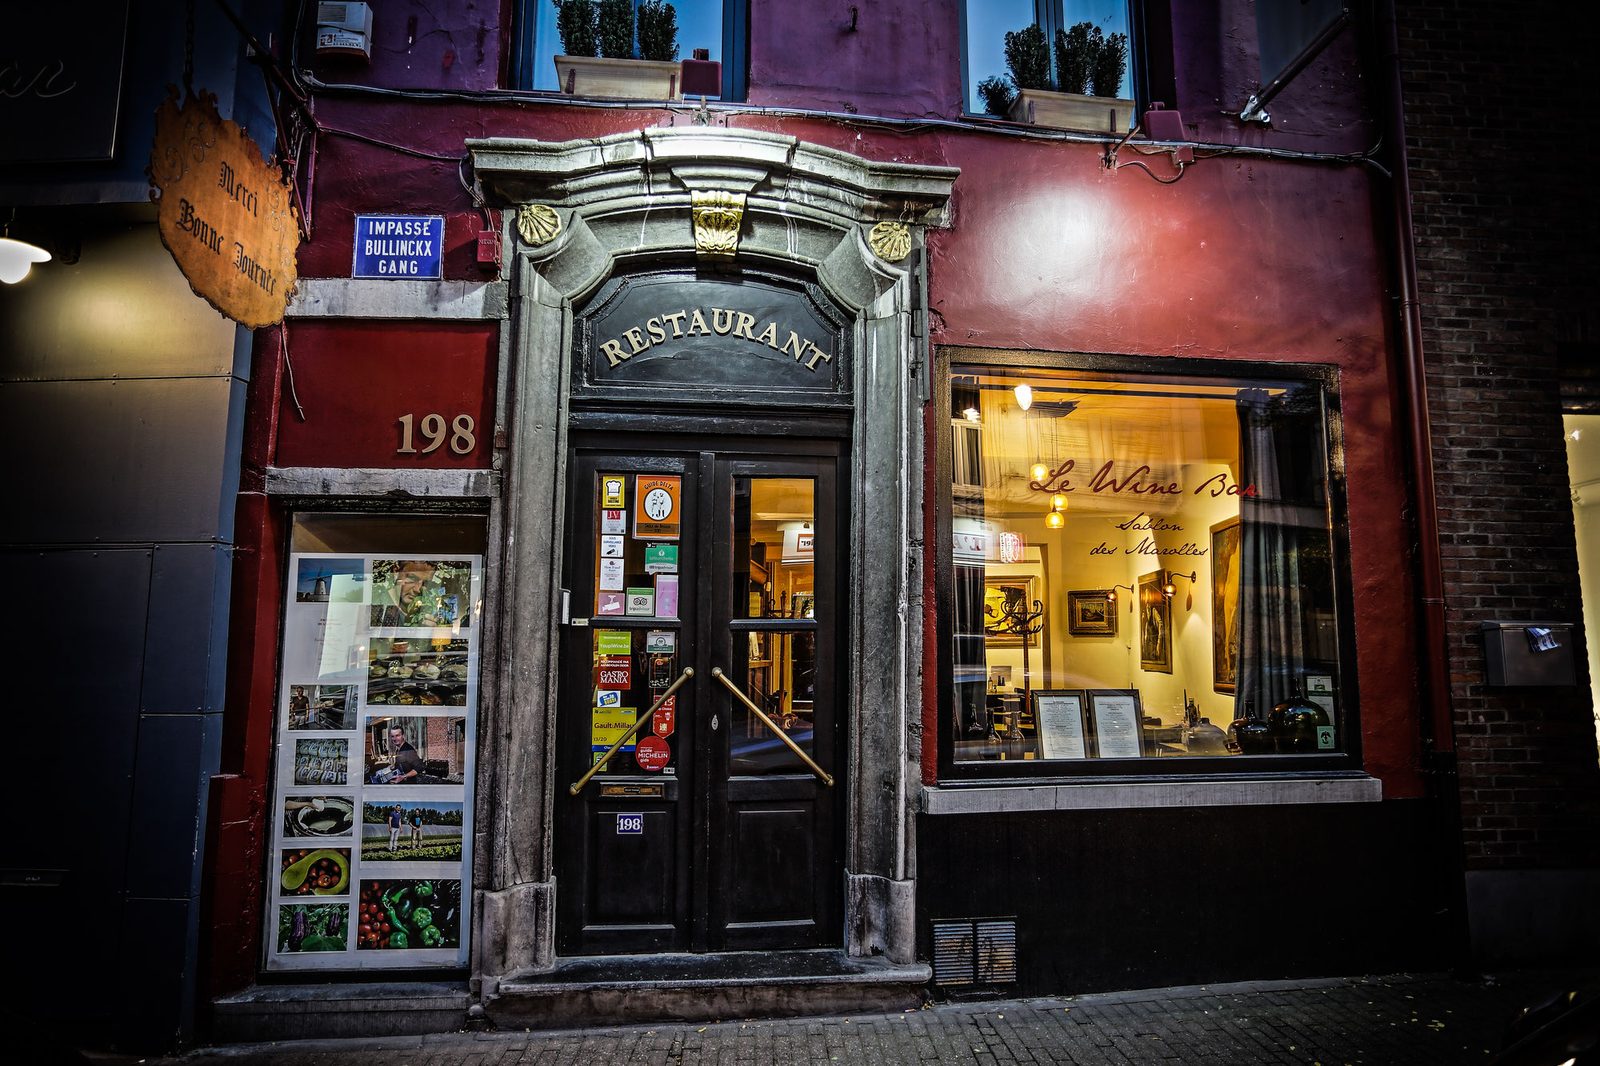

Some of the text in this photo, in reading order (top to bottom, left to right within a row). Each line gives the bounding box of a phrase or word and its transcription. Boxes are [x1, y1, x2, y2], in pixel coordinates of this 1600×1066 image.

[217, 160, 258, 217] Merci
[175, 198, 225, 256] Bonne
[368, 220, 432, 236] IMPASSE
[364, 239, 433, 257] BULLINCKX
[377, 259, 419, 274] GANG
[600, 307, 832, 372] RESTAURANT
[396, 412, 476, 455] 198
[1029, 458, 1259, 498] Le Wine Bar
[1114, 511, 1185, 532] Sablon
[1089, 536, 1209, 557] des Marolles
[600, 670, 629, 678] GASTRO
[618, 818, 641, 831] 198
